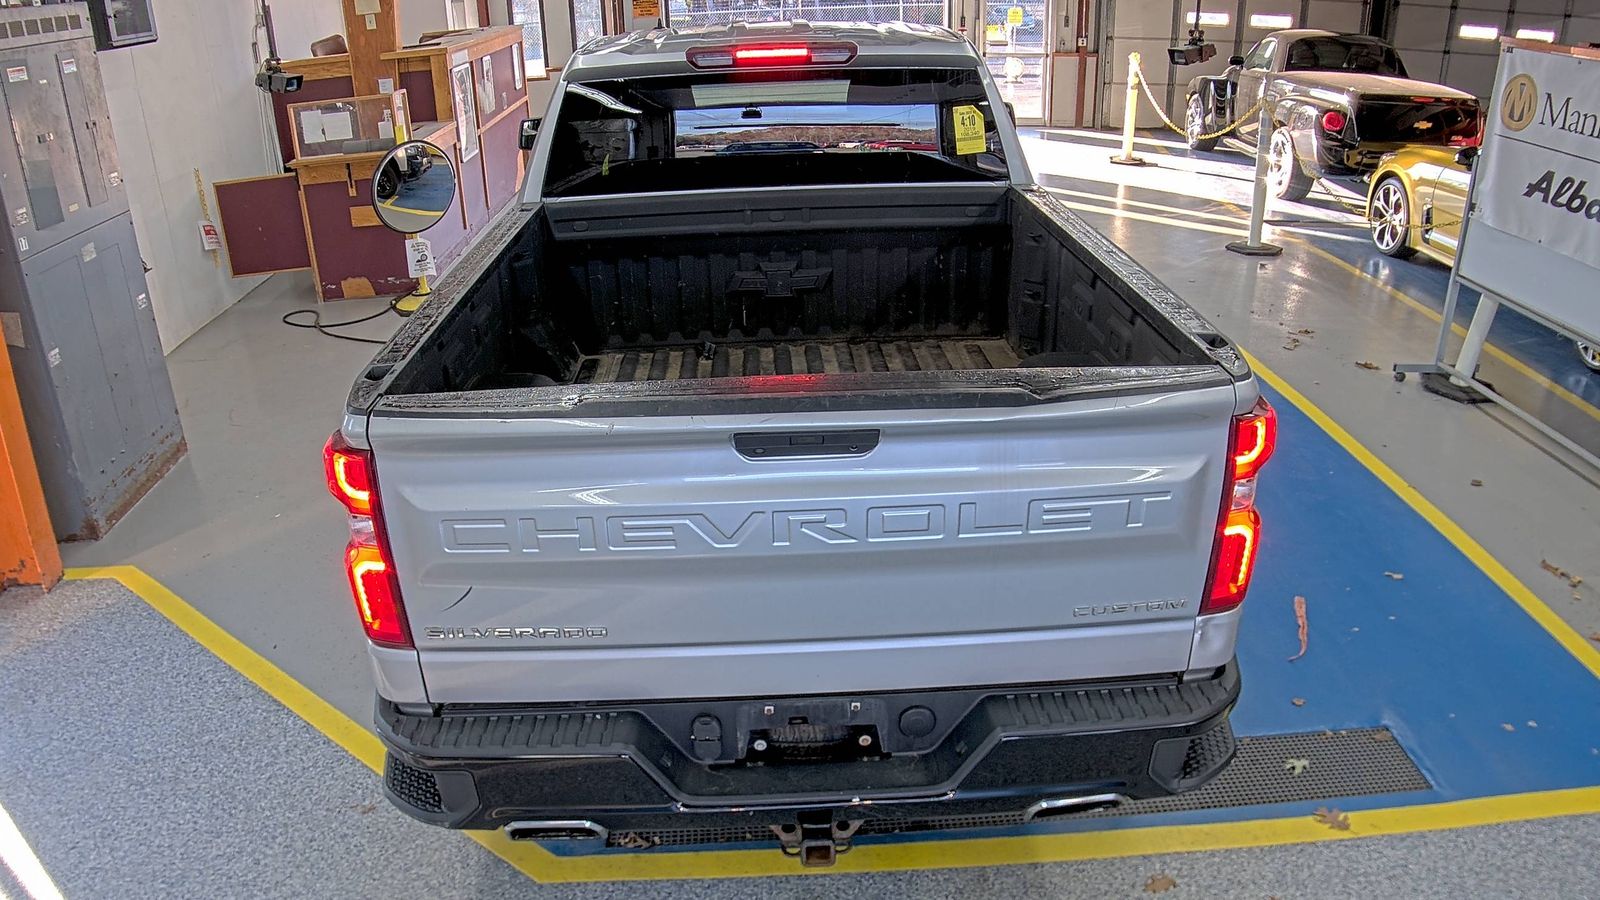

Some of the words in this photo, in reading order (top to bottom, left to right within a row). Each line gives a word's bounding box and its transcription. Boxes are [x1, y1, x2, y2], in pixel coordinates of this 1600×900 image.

[961, 114, 976, 127] 4:10
[1538, 92, 1600, 139] Man
[439, 490, 1172, 554] CHEVROLET
[1073, 599, 1187, 617] CUSTOM
[424, 626, 608, 640] SILVERADO
